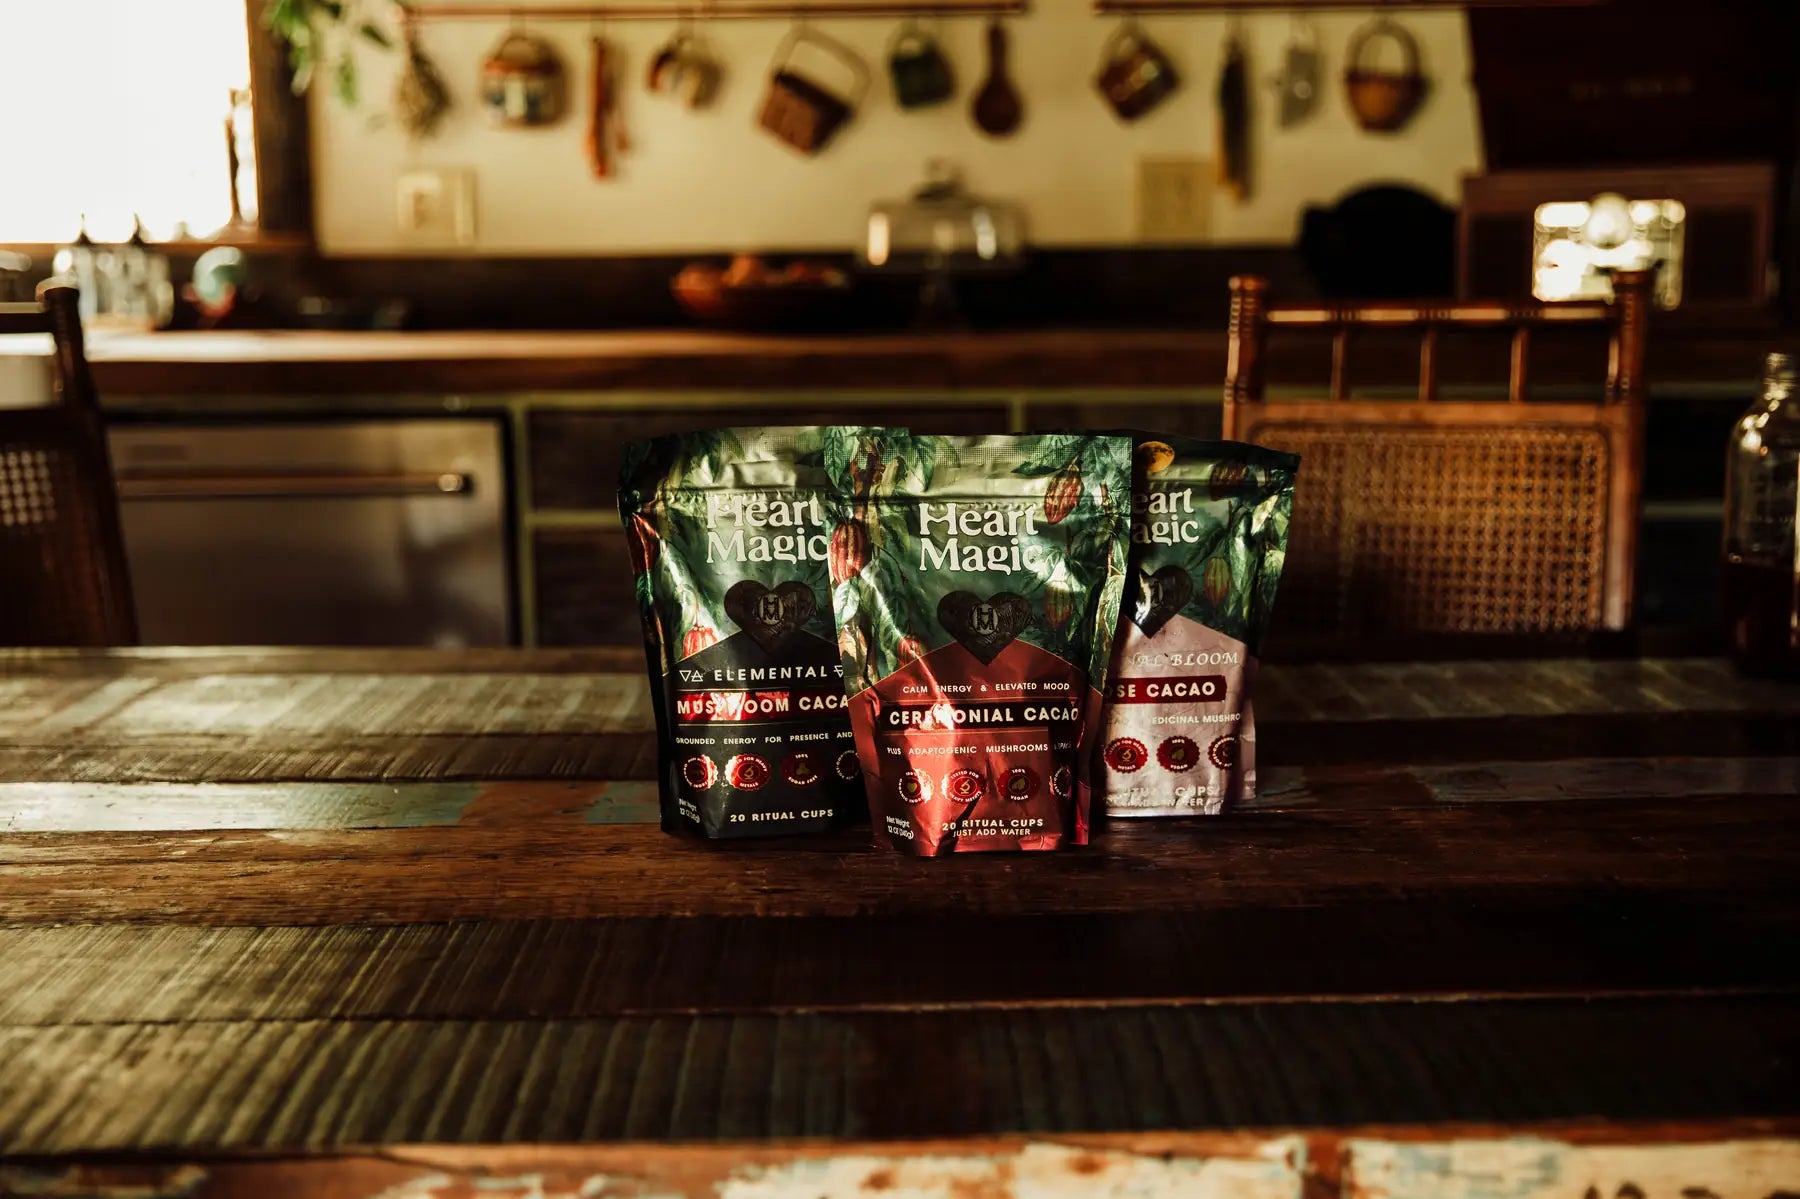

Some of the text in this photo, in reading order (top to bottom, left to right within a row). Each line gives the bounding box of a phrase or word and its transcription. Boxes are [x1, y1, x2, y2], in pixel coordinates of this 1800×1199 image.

[1132, 487, 1195, 515] eart
[706, 494, 825, 529] Heart
[919, 502, 1039, 537] Heart
[1132, 513, 1200, 547] agic
[706, 527, 829, 564] Magic
[919, 537, 1045, 576] Magic
[1170, 651, 1239, 667] BLOOM
[714, 665, 828, 682] ELEMENTAL
[903, 685, 928, 693] CALM
[980, 684, 988, 692] &
[995, 682, 1038, 691] ELEVATED
[1043, 682, 1070, 690] MOOD
[1146, 681, 1216, 698] CACAO
[677, 694, 849, 715] MUSOOM CACA
[889, 706, 1079, 725] CEREONIAL CACAO
[1152, 712, 1242, 725] EDICINAL MUSHRO
[676, 737, 716, 745] GROUNDED
[723, 737, 757, 745] ENERGY
[790, 732, 829, 742] PRESENCE
[836, 731, 853, 739] AND
[887, 747, 902, 755] PLUS
[908, 746, 978, 755] ADAPTOGENIC
[985, 743, 1049, 753] MUSHROOMS
[730, 809, 834, 823] 20 RITUAL CUPS
[942, 818, 1044, 831] 20 RITUAL CUPS
[953, 828, 1031, 837] JUST ADD WATER
